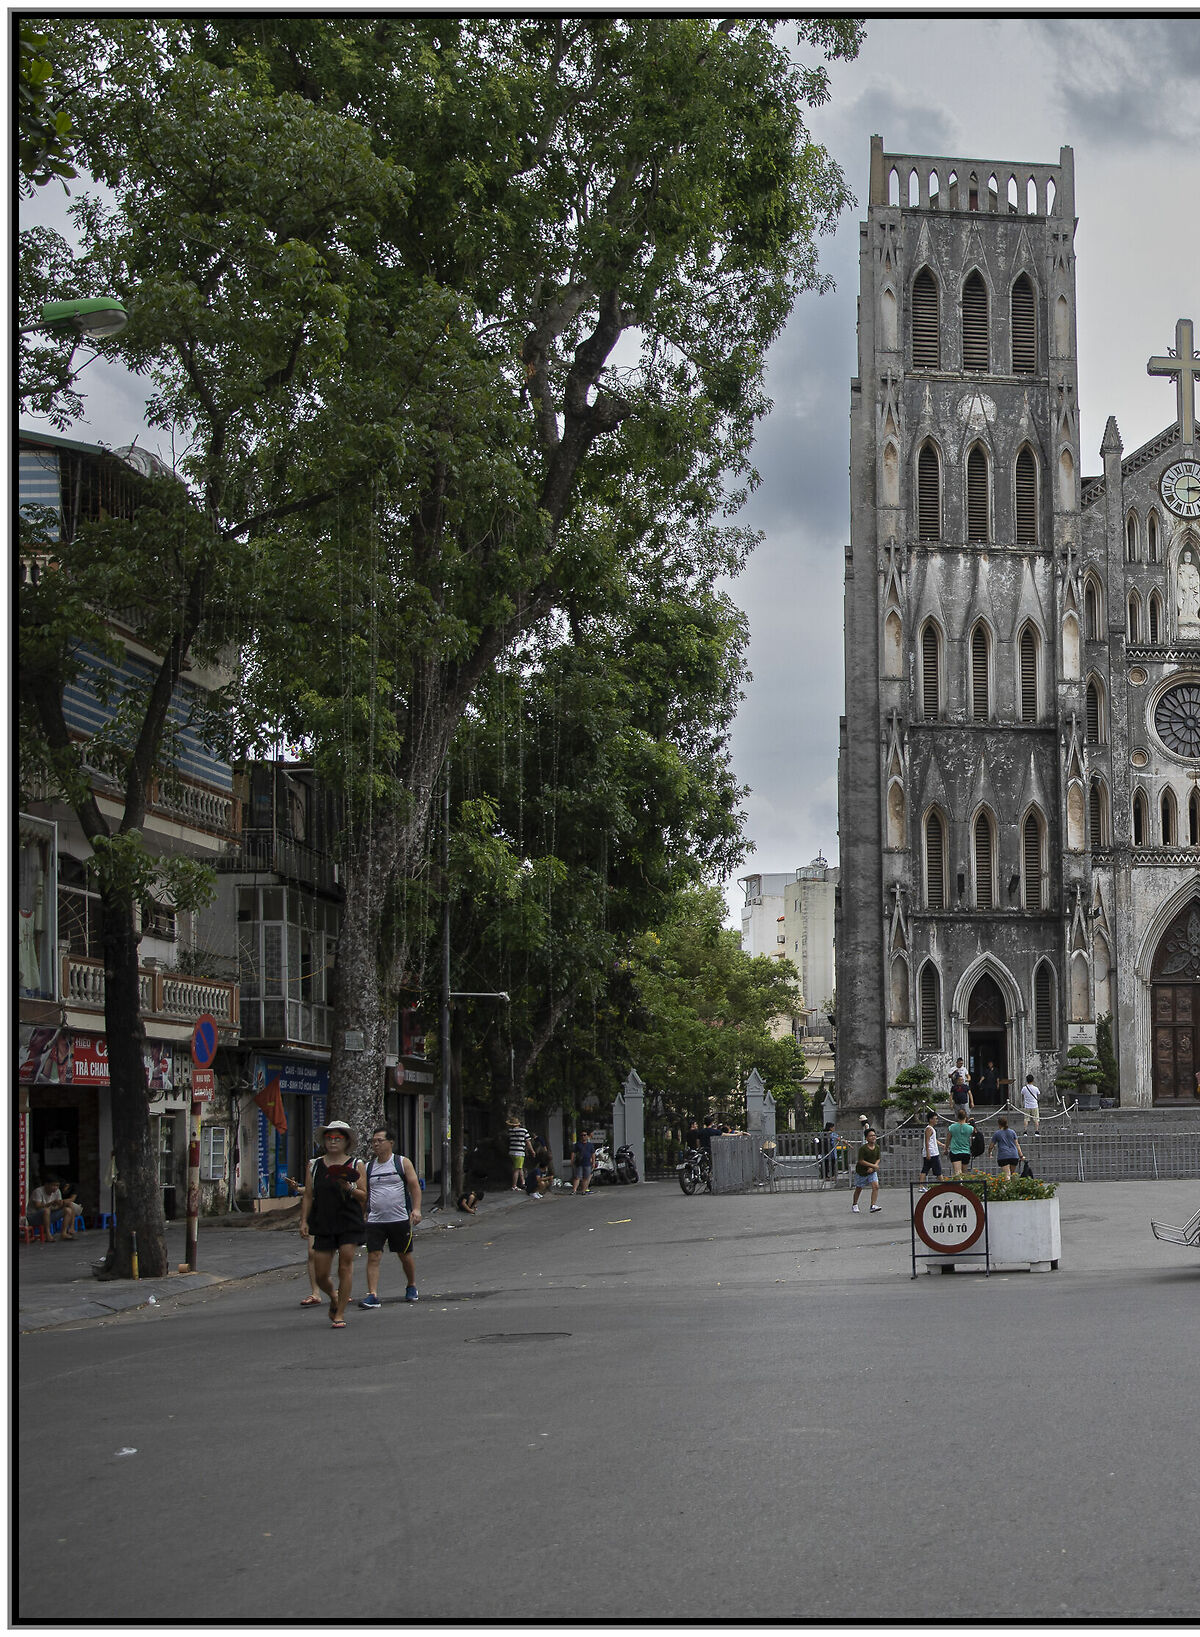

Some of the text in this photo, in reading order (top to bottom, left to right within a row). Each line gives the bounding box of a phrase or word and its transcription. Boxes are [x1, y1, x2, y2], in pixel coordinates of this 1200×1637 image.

[75, 1058, 89, 1076] TRÀ
[932, 1200, 967, 1219] CẤM
[947, 1223, 954, 1233] Ô
[956, 1223, 968, 1233] TÔ
